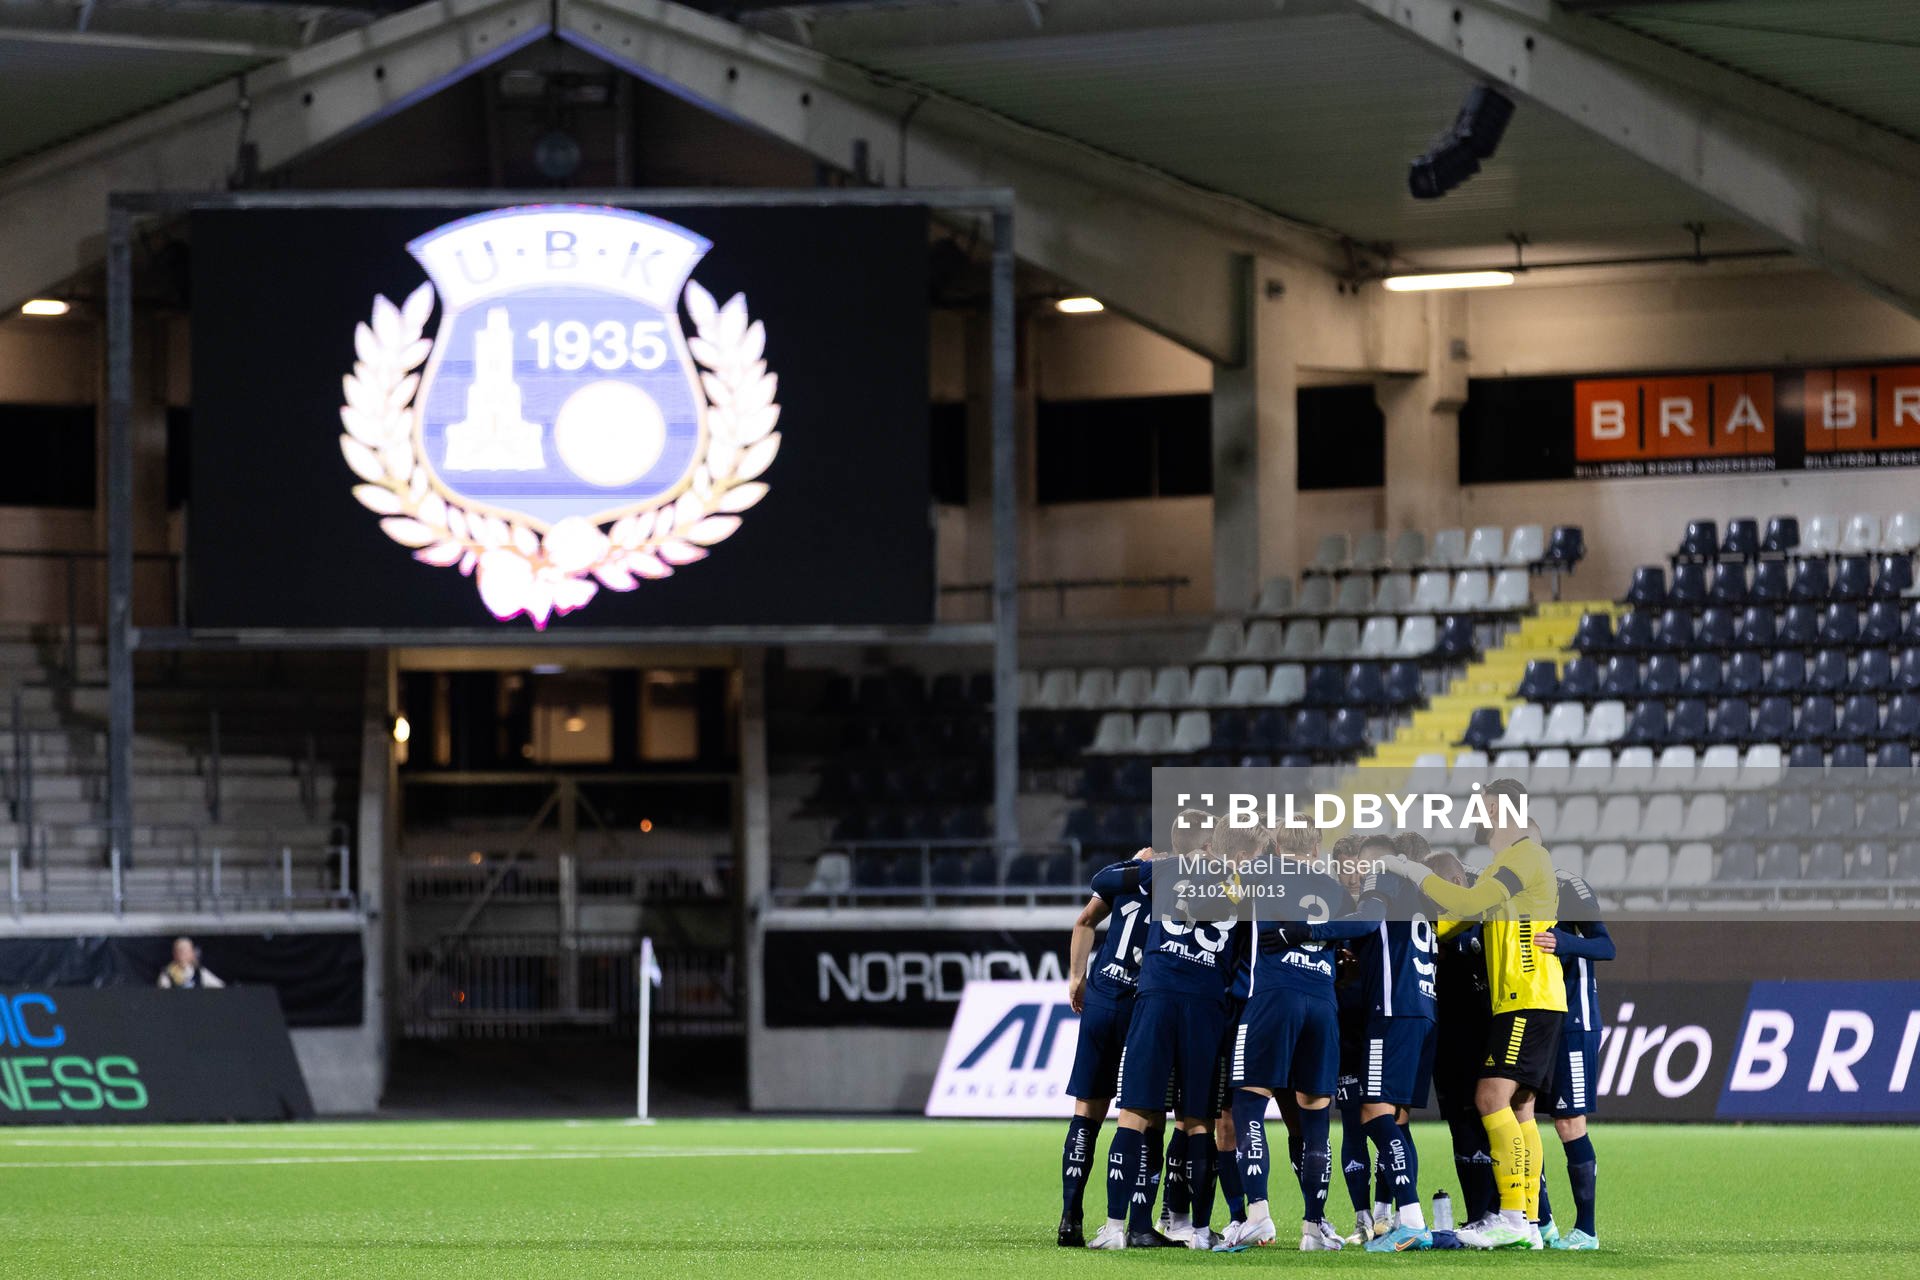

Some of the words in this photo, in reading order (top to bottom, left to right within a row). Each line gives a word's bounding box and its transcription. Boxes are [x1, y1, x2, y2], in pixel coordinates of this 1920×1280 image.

[527, 320, 668, 371] 1935
[1115, 900, 1151, 967] 1
[0, 993, 66, 1048] IC
[1069, 1127, 1090, 1163] Enviro
[1248, 1120, 1262, 1160] Enviro
[1389, 1139, 1406, 1171] Enviro
[1510, 1137, 1522, 1175] Enviro
